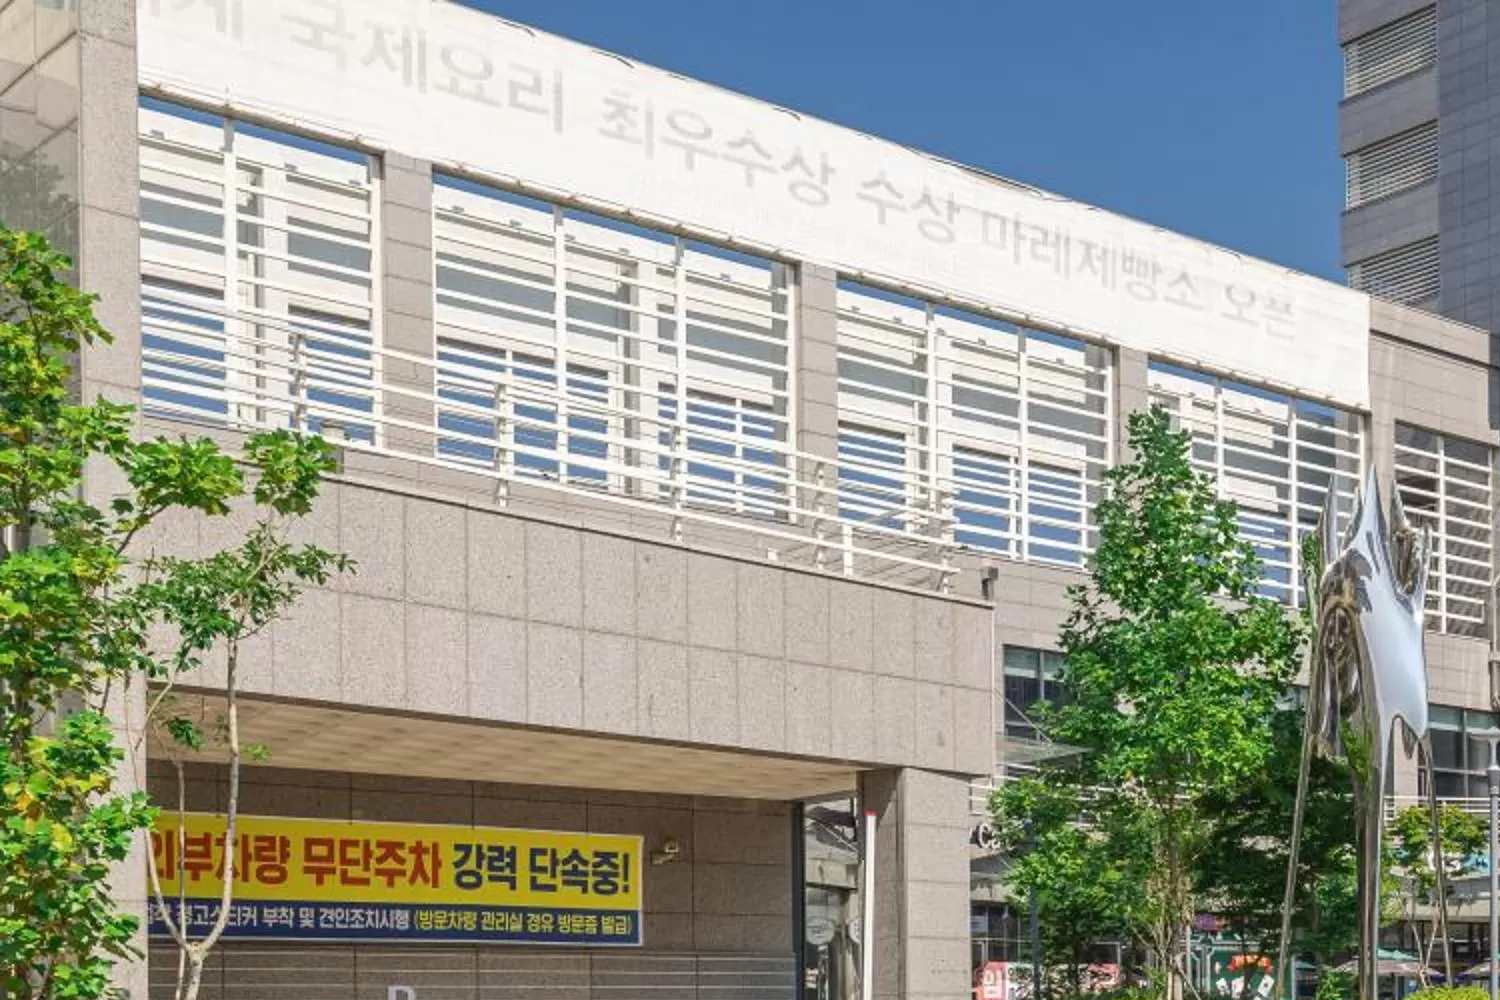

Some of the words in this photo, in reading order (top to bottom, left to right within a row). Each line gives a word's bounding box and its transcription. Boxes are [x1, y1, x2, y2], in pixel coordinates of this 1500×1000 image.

[280, 10, 565, 134] 국제요리
[596, 86, 837, 207] 최우수상
[855, 172, 961, 244] 수상
[979, 209, 1201, 310] 마레제빵소
[1220, 281, 1298, 342] 오픈
[302, 836, 443, 889] 무단주차
[452, 842, 518, 892] 강력
[529, 846, 630, 896] 단속중!
[262, 904, 295, 928] 부착
[299, 906, 316, 929] 및
[319, 906, 410, 930] 견인조치시행
[414, 909, 478, 931] (방문차량
[480, 911, 524, 933] 관리실
[526, 912, 555, 934] 경유
[558, 914, 598, 935] 방문증
